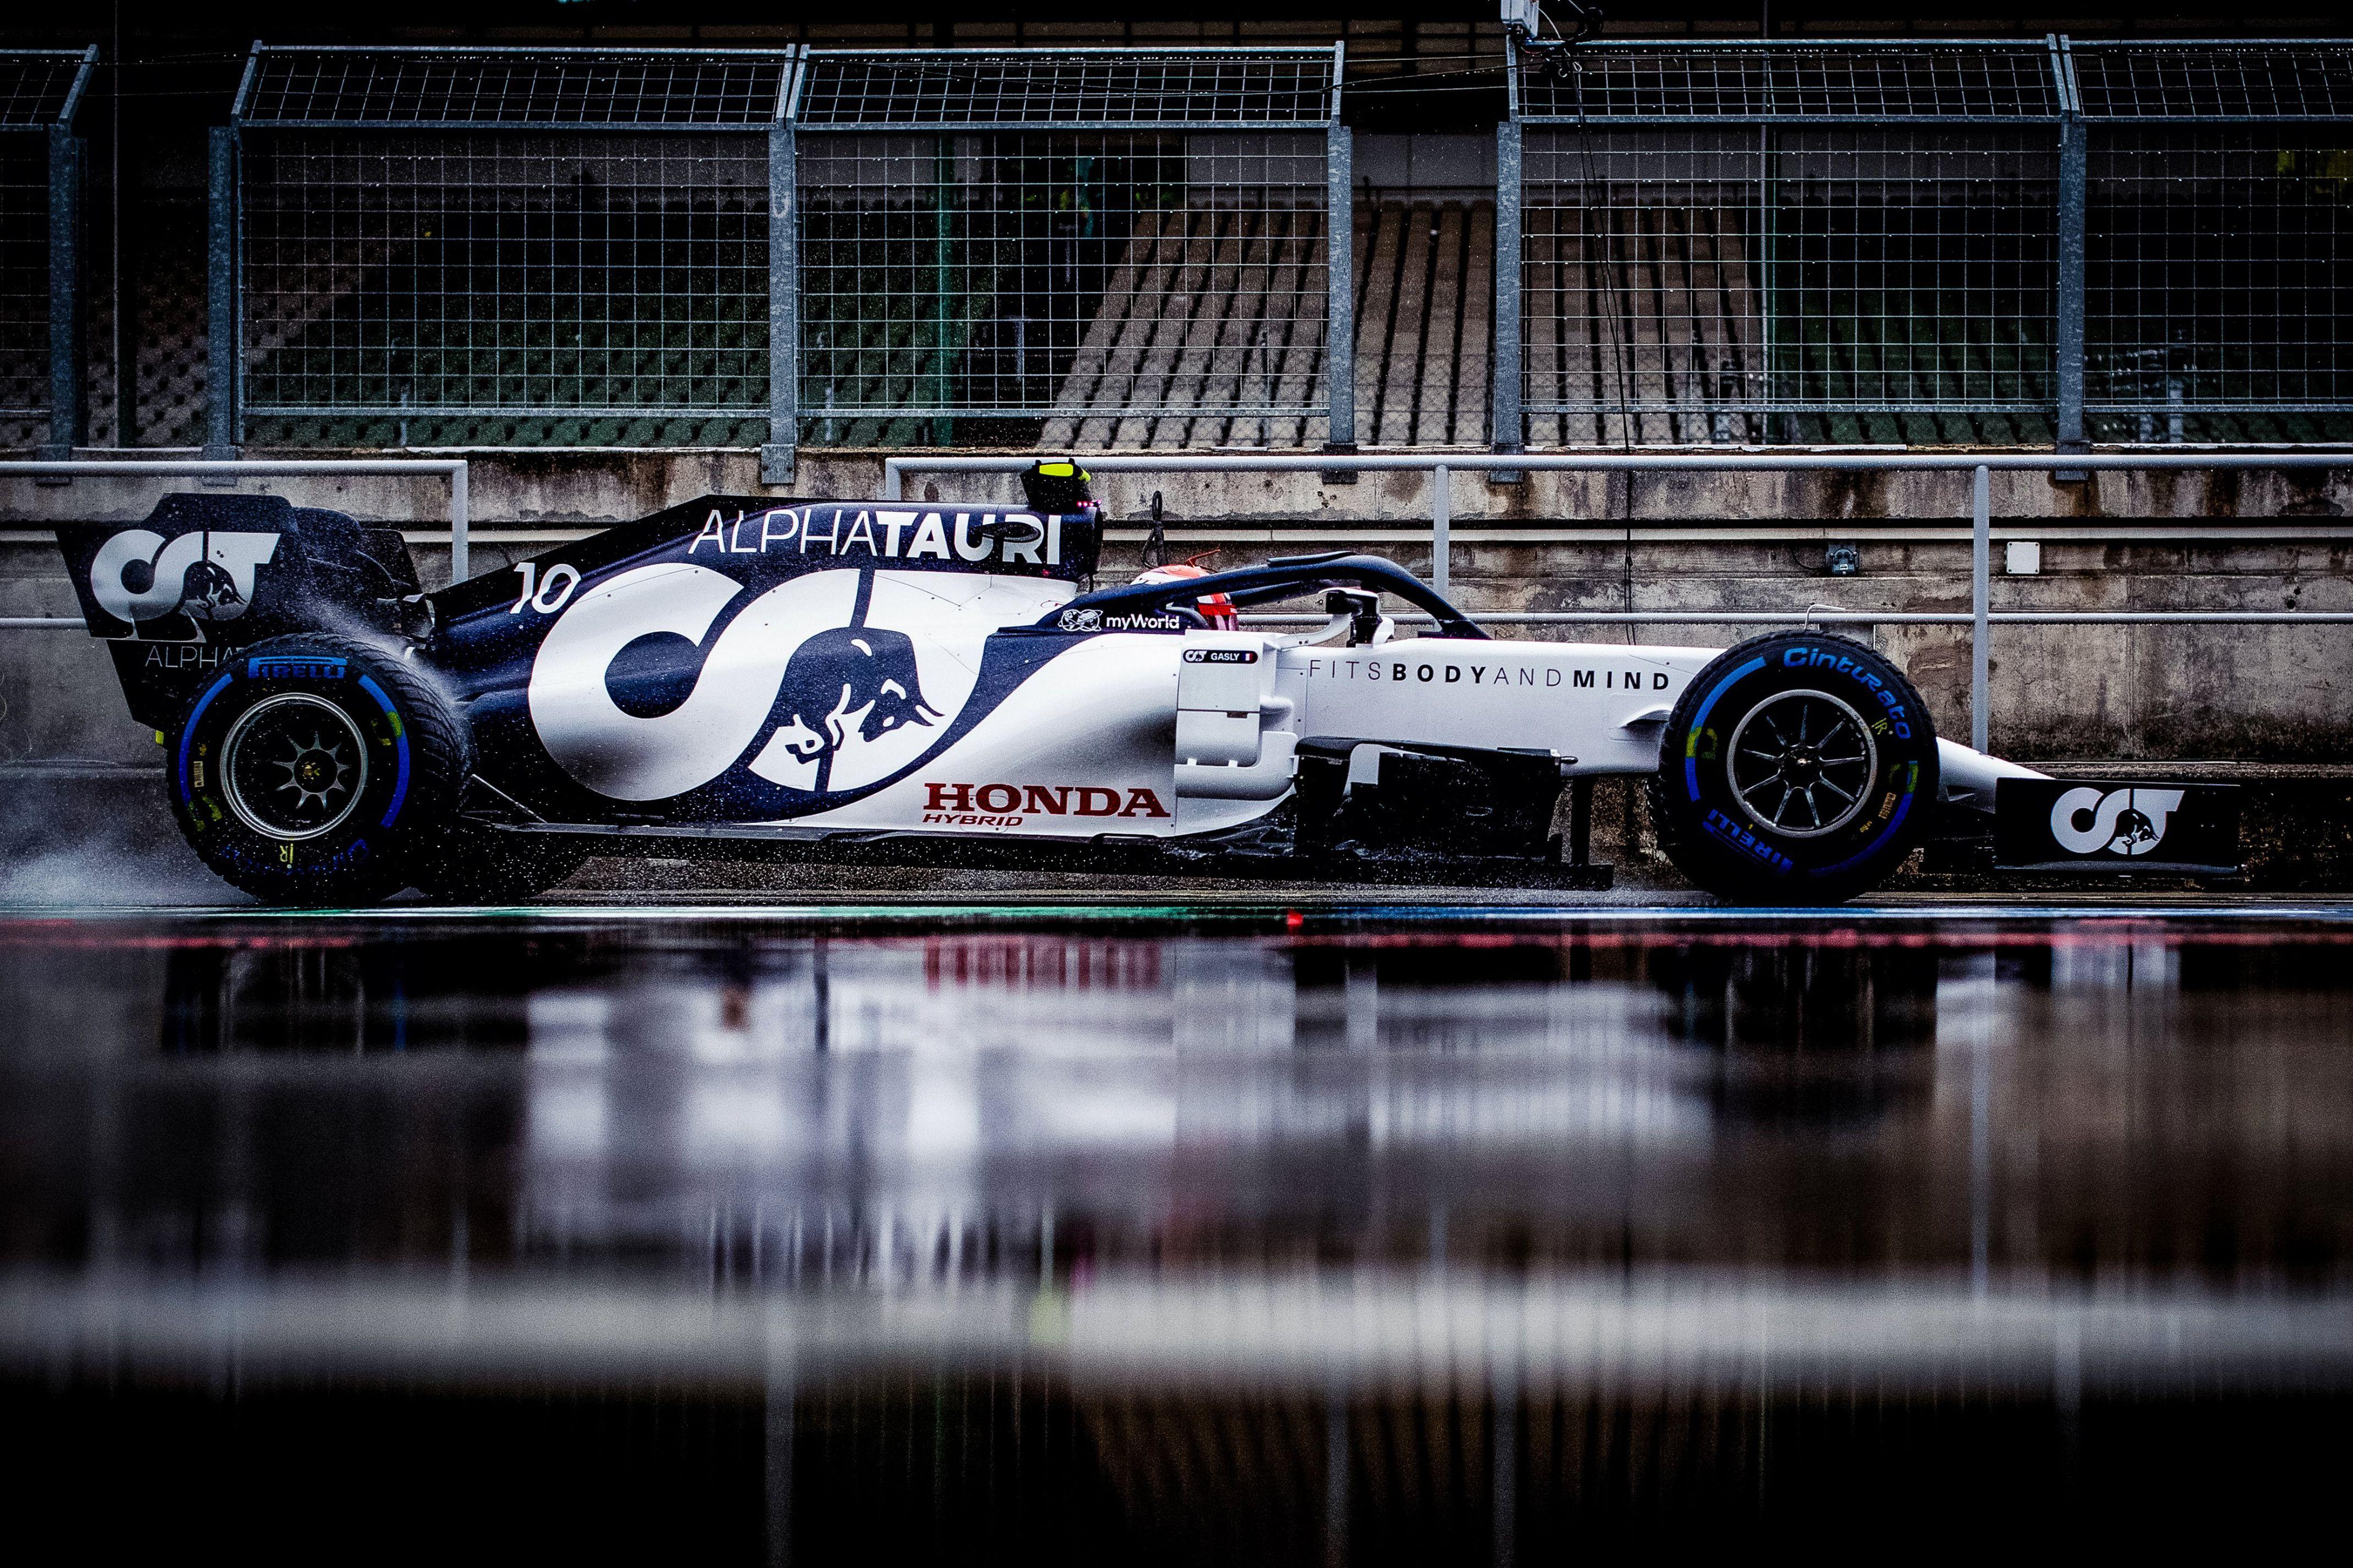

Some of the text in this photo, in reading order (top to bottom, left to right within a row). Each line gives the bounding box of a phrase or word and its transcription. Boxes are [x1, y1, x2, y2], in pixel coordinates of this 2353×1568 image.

[688, 508, 1062, 565] ALPHATAURI
[510, 562, 582, 614] 10
[1106, 614, 1180, 630] myWorld
[248, 655, 348, 679] PIRELLI
[1211, 653, 1240, 661] GASLY
[924, 783, 1171, 818] HONDA
[923, 813, 1023, 827] HYBRID
[1702, 809, 1793, 875] PIRELLI
